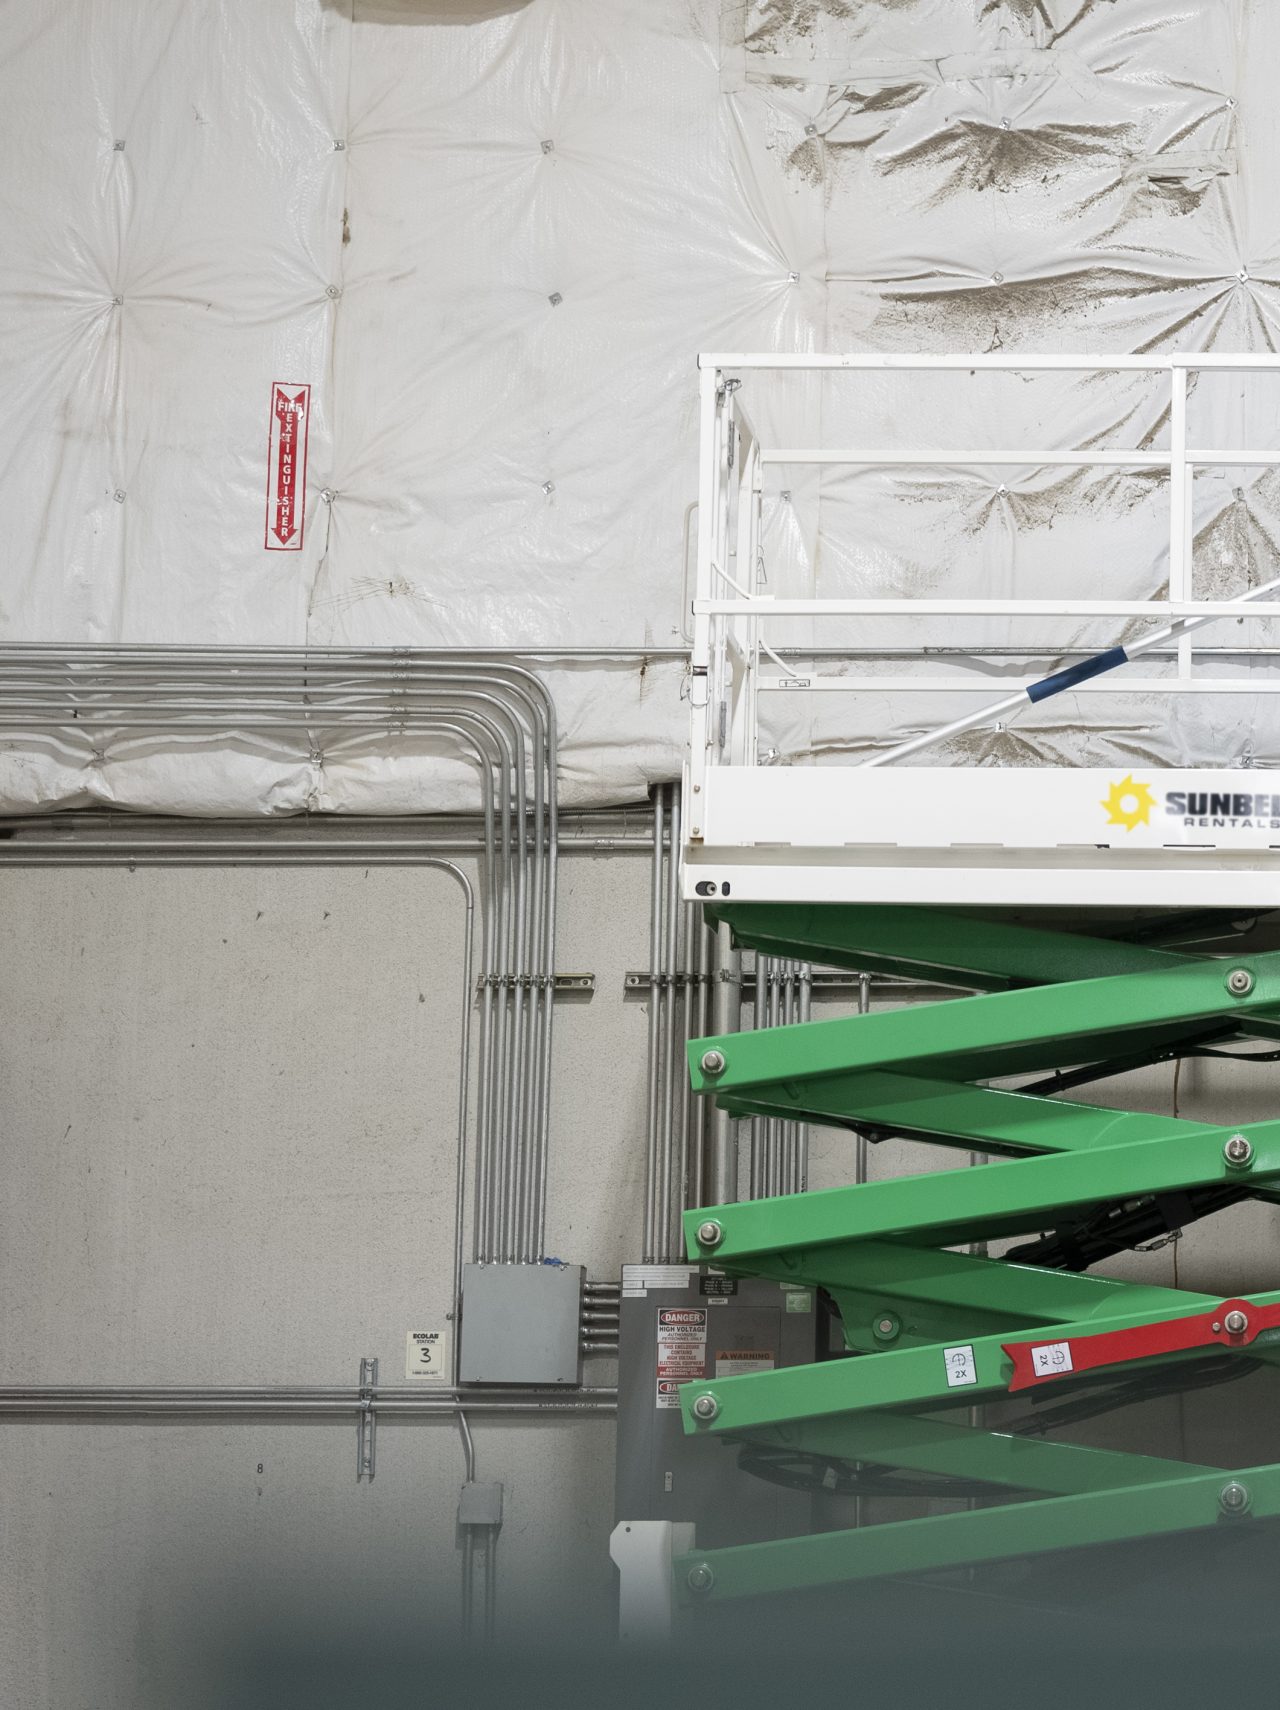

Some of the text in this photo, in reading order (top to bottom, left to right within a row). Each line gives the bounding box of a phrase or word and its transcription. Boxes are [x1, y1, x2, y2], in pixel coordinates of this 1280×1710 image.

[281, 413, 293, 537] EXTINGUISHER
[1184, 818, 1280, 829] RENTALS
[665, 1313, 700, 1322] DANGER
[420, 1347, 432, 1363] 3
[730, 1352, 770, 1360] WARNING
[955, 1369, 967, 1379] 2X
